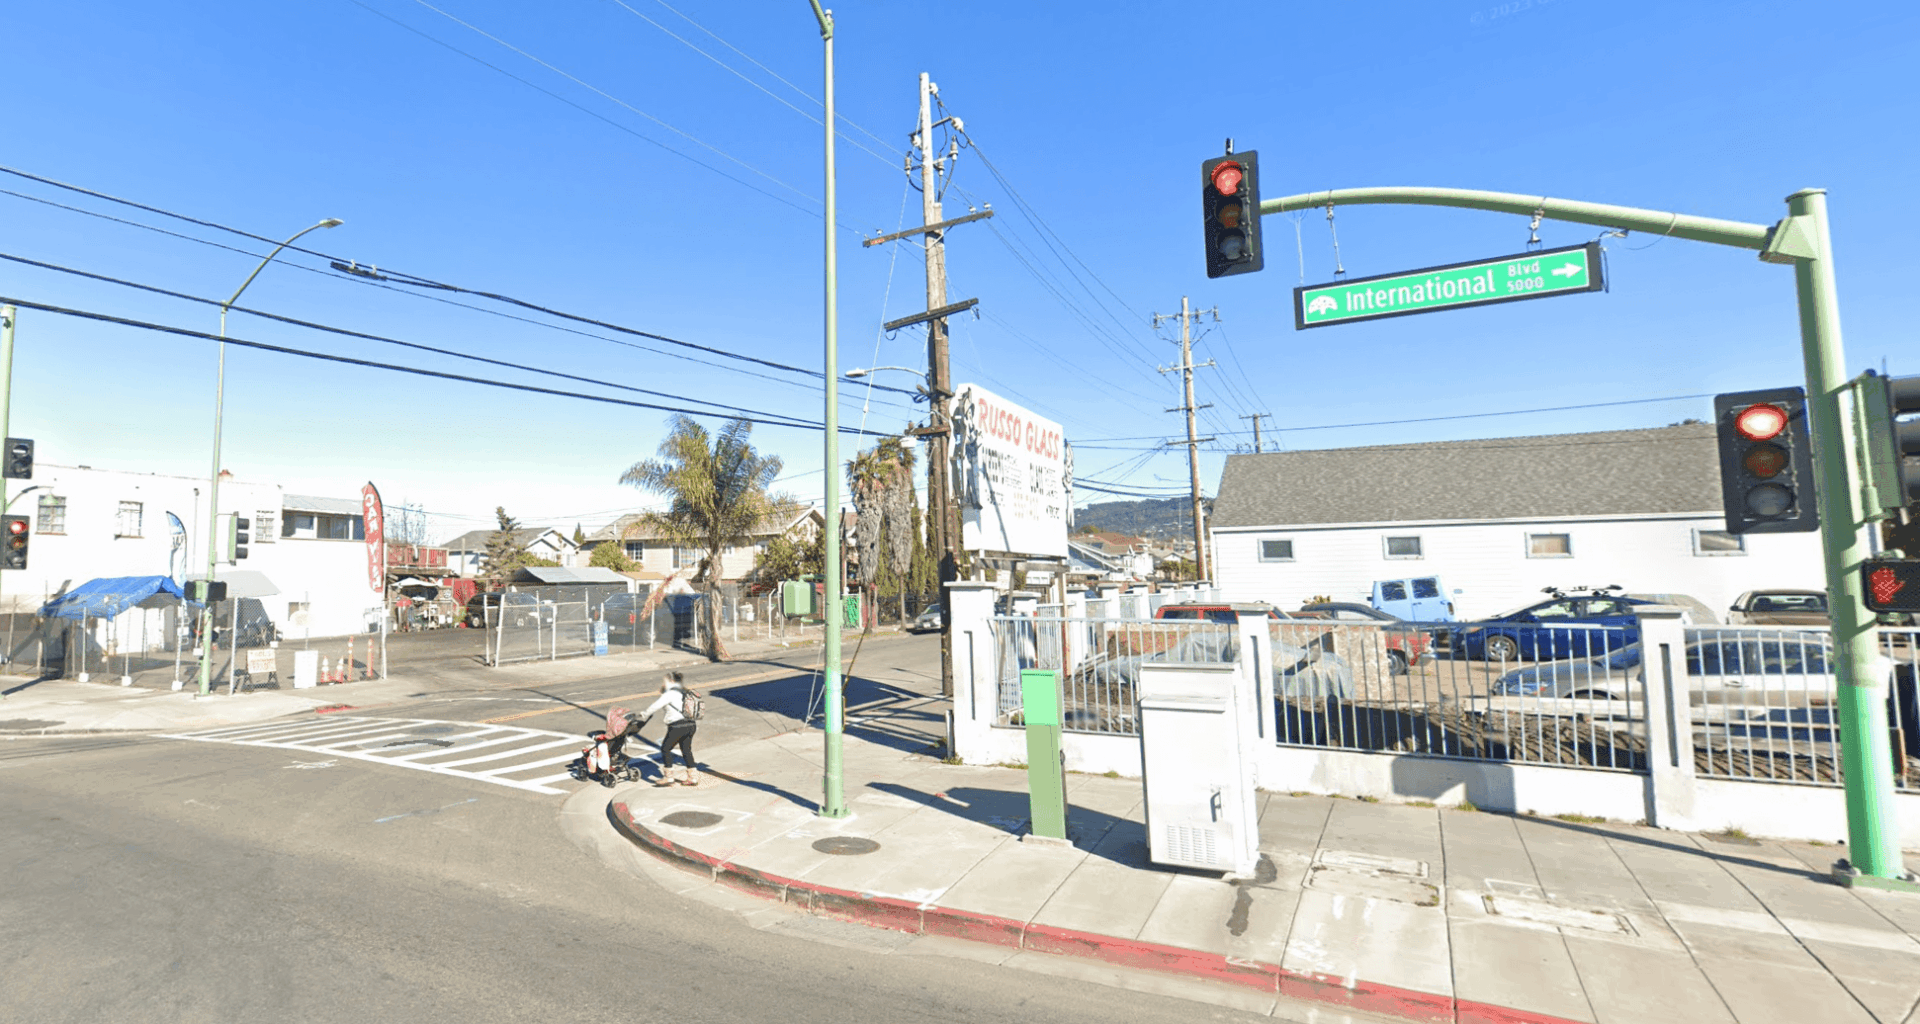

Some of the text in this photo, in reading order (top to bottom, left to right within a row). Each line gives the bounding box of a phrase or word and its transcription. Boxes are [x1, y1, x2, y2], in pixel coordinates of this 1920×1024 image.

[1346, 260, 1540, 312] International Blvd
[1507, 276, 1544, 293] 5000
[978, 398, 1060, 461] RUSSO GLASS
